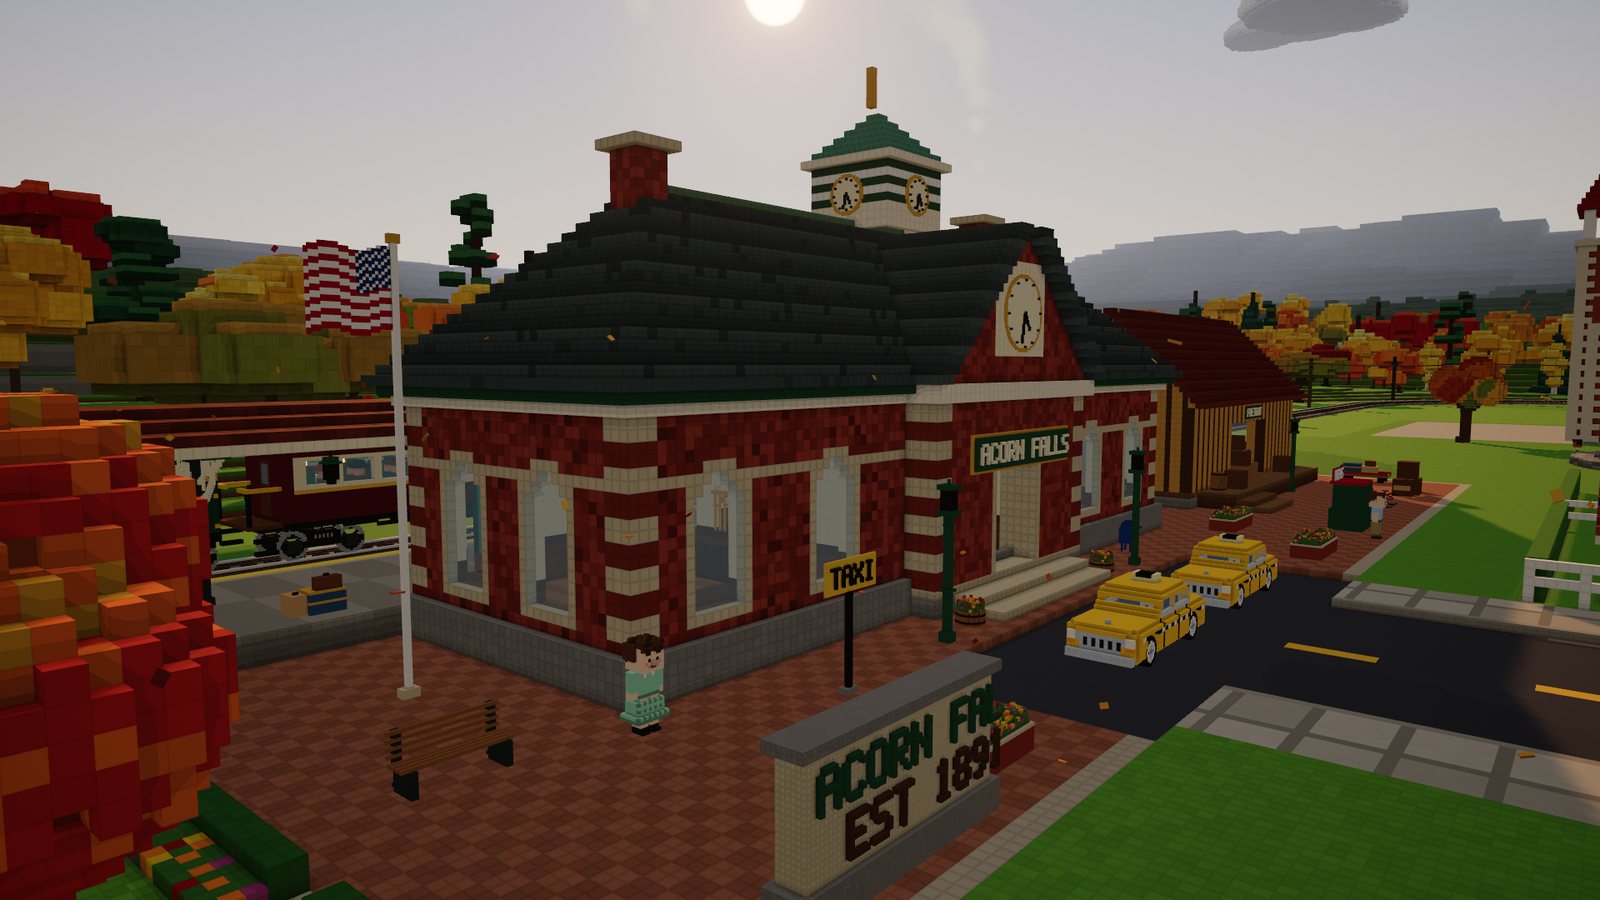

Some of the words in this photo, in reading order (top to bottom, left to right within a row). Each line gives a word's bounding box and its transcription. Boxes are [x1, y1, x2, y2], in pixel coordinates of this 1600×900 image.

[980, 438, 1025, 466] ACORN
[1031, 433, 1070, 458] FALLS
[830, 558, 874, 590] TAXI
[815, 714, 934, 820] ACORN
[845, 777, 916, 862] EST
[936, 727, 1001, 804] 1891
